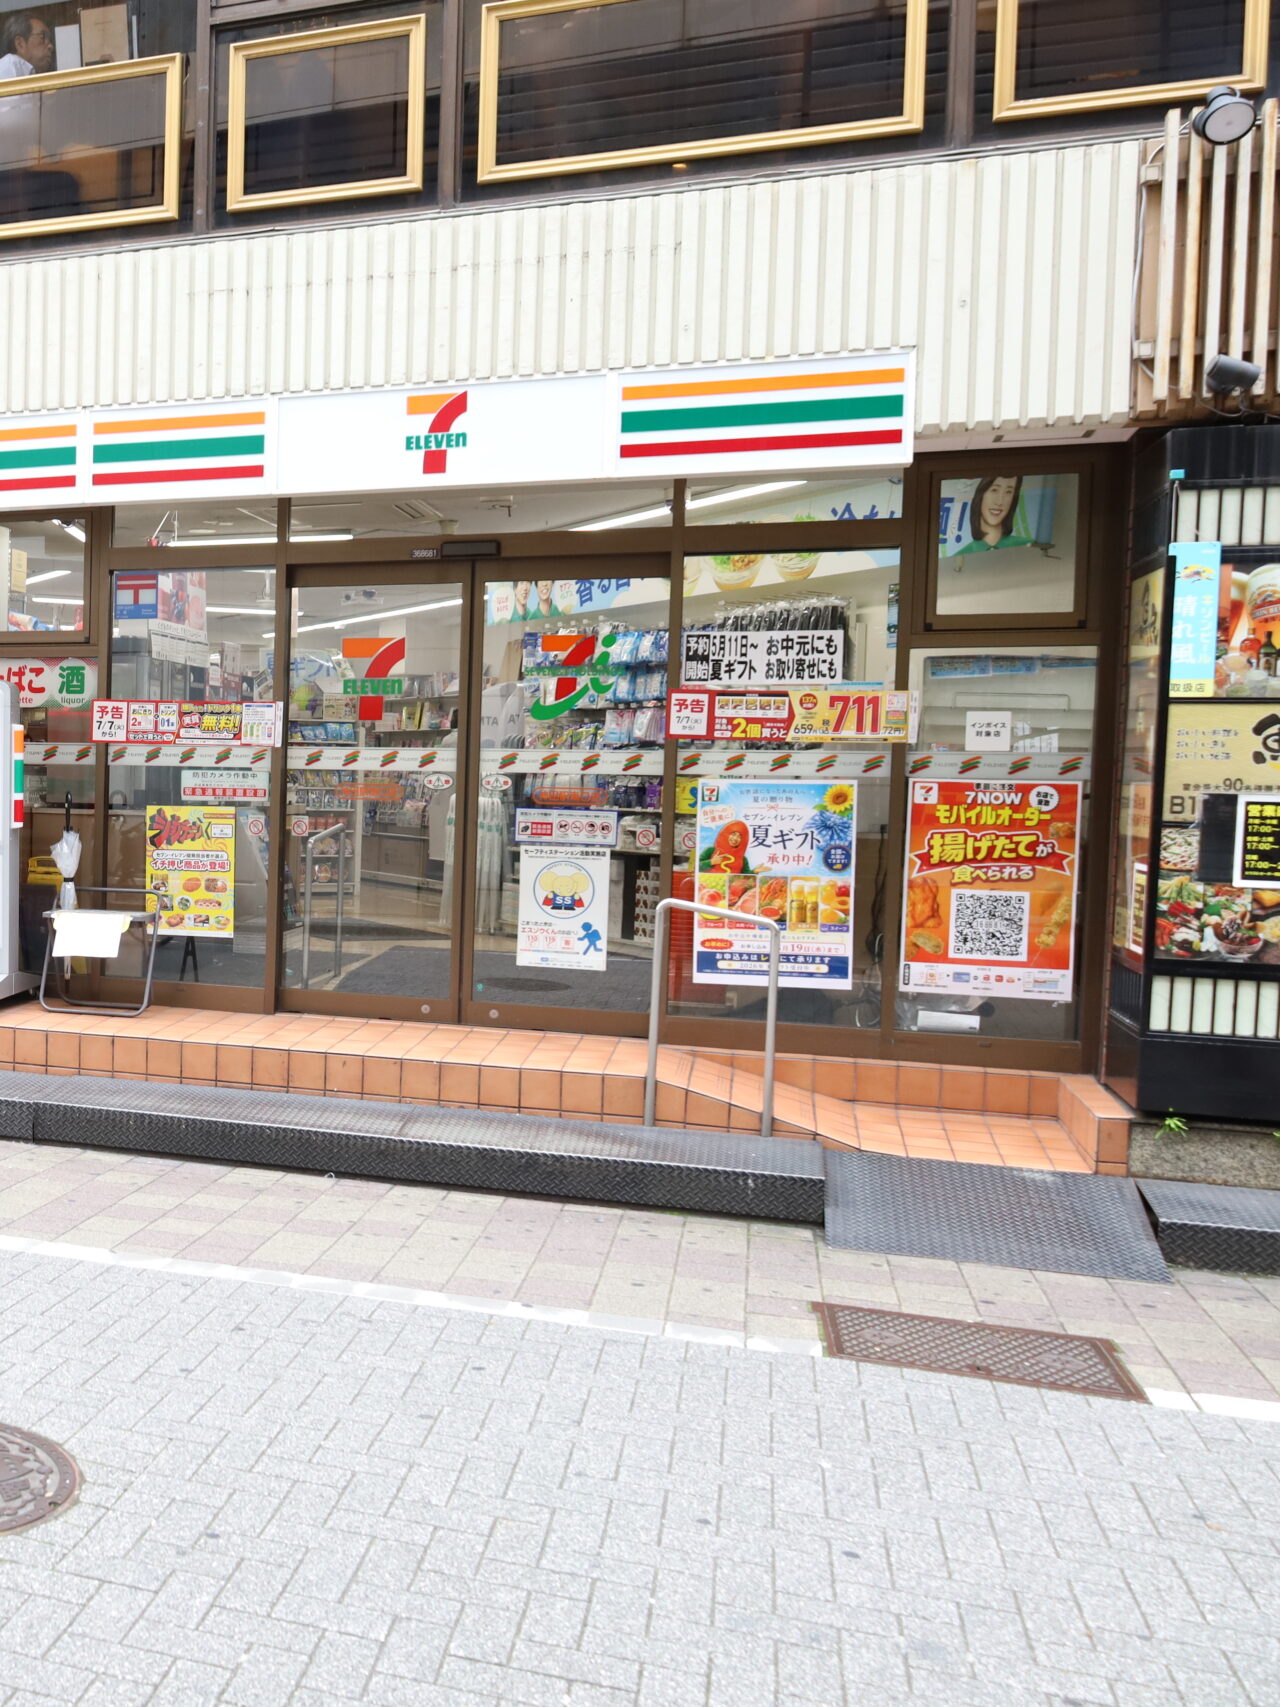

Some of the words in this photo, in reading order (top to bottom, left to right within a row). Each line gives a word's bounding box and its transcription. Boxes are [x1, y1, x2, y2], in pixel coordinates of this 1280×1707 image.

[406, 390, 468, 475] 7
[1171, 594, 1198, 665] 晴れ風
[686, 634, 710, 658] 予約
[766, 635, 838, 656] お中元にも
[685, 660, 709, 681] 開始
[710, 660, 757, 681] 夏ギフト
[765, 659, 838, 681] お取り寄せにも
[58, 665, 86, 694] 酒
[1169, 682, 1206, 693] 取扱店
[60, 697, 86, 706] liquor
[673, 697, 705, 713] 予告
[96, 705, 124, 720] 予告
[828, 695, 880, 734] 711
[201, 714, 241, 732] 無料!
[731, 717, 762, 738] 2個
[762, 728, 788, 738] 買うと
[969, 721, 1007, 729] インボイス
[975, 730, 1002, 738] 対象店
[192, 771, 258, 779] 防犯カメラ作動中
[965, 791, 1023, 805] 7NOW
[935, 804, 1052, 827] モバイルオーダー
[1246, 804, 1280, 818] 営業
[749, 824, 822, 851] 夏ギフト
[929, 832, 1054, 864] 揚げたてが
[151, 859, 230, 871] イチ押し商品が登場!
[767, 853, 814, 866] 承り中!
[951, 864, 1035, 884] 食べられる
[556, 896, 572, 905] SS
[715, 953, 831, 964] お申込みはレにて承ります
